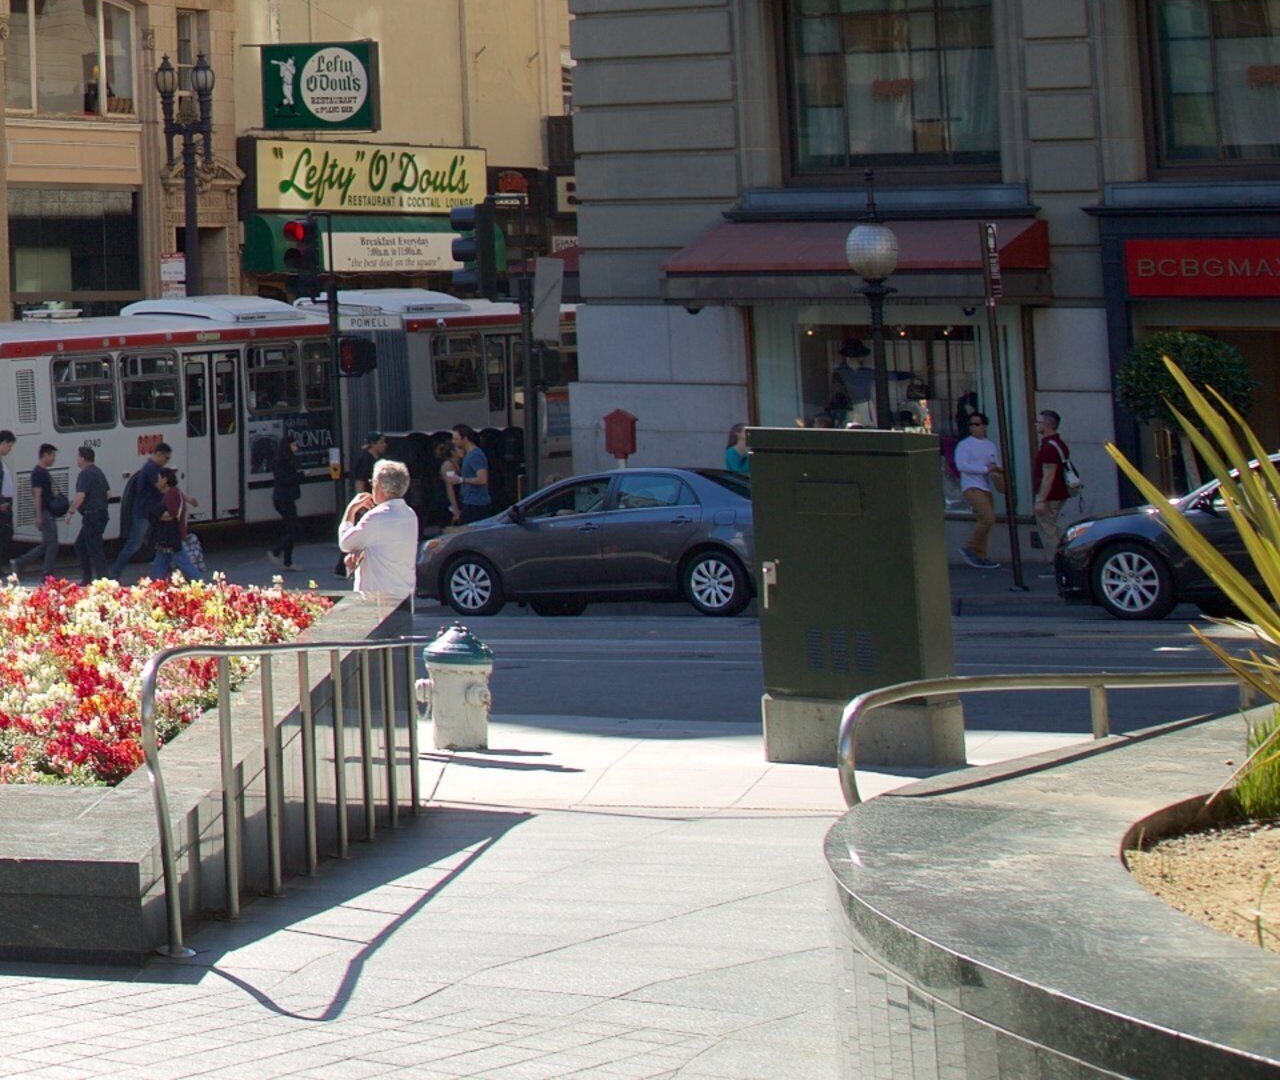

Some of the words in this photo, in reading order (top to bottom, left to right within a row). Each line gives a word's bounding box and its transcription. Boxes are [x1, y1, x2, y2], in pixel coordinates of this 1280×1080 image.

[316, 55, 354, 77] Lefty
[311, 96, 357, 105] RESTAURANT
[347, 195, 396, 207] RESTAURANT
[407, 198, 441, 208] COCKTAIL
[360, 237, 396, 246] Breakfast
[398, 237, 429, 247] Everyday
[350, 318, 389, 327] POWELL
